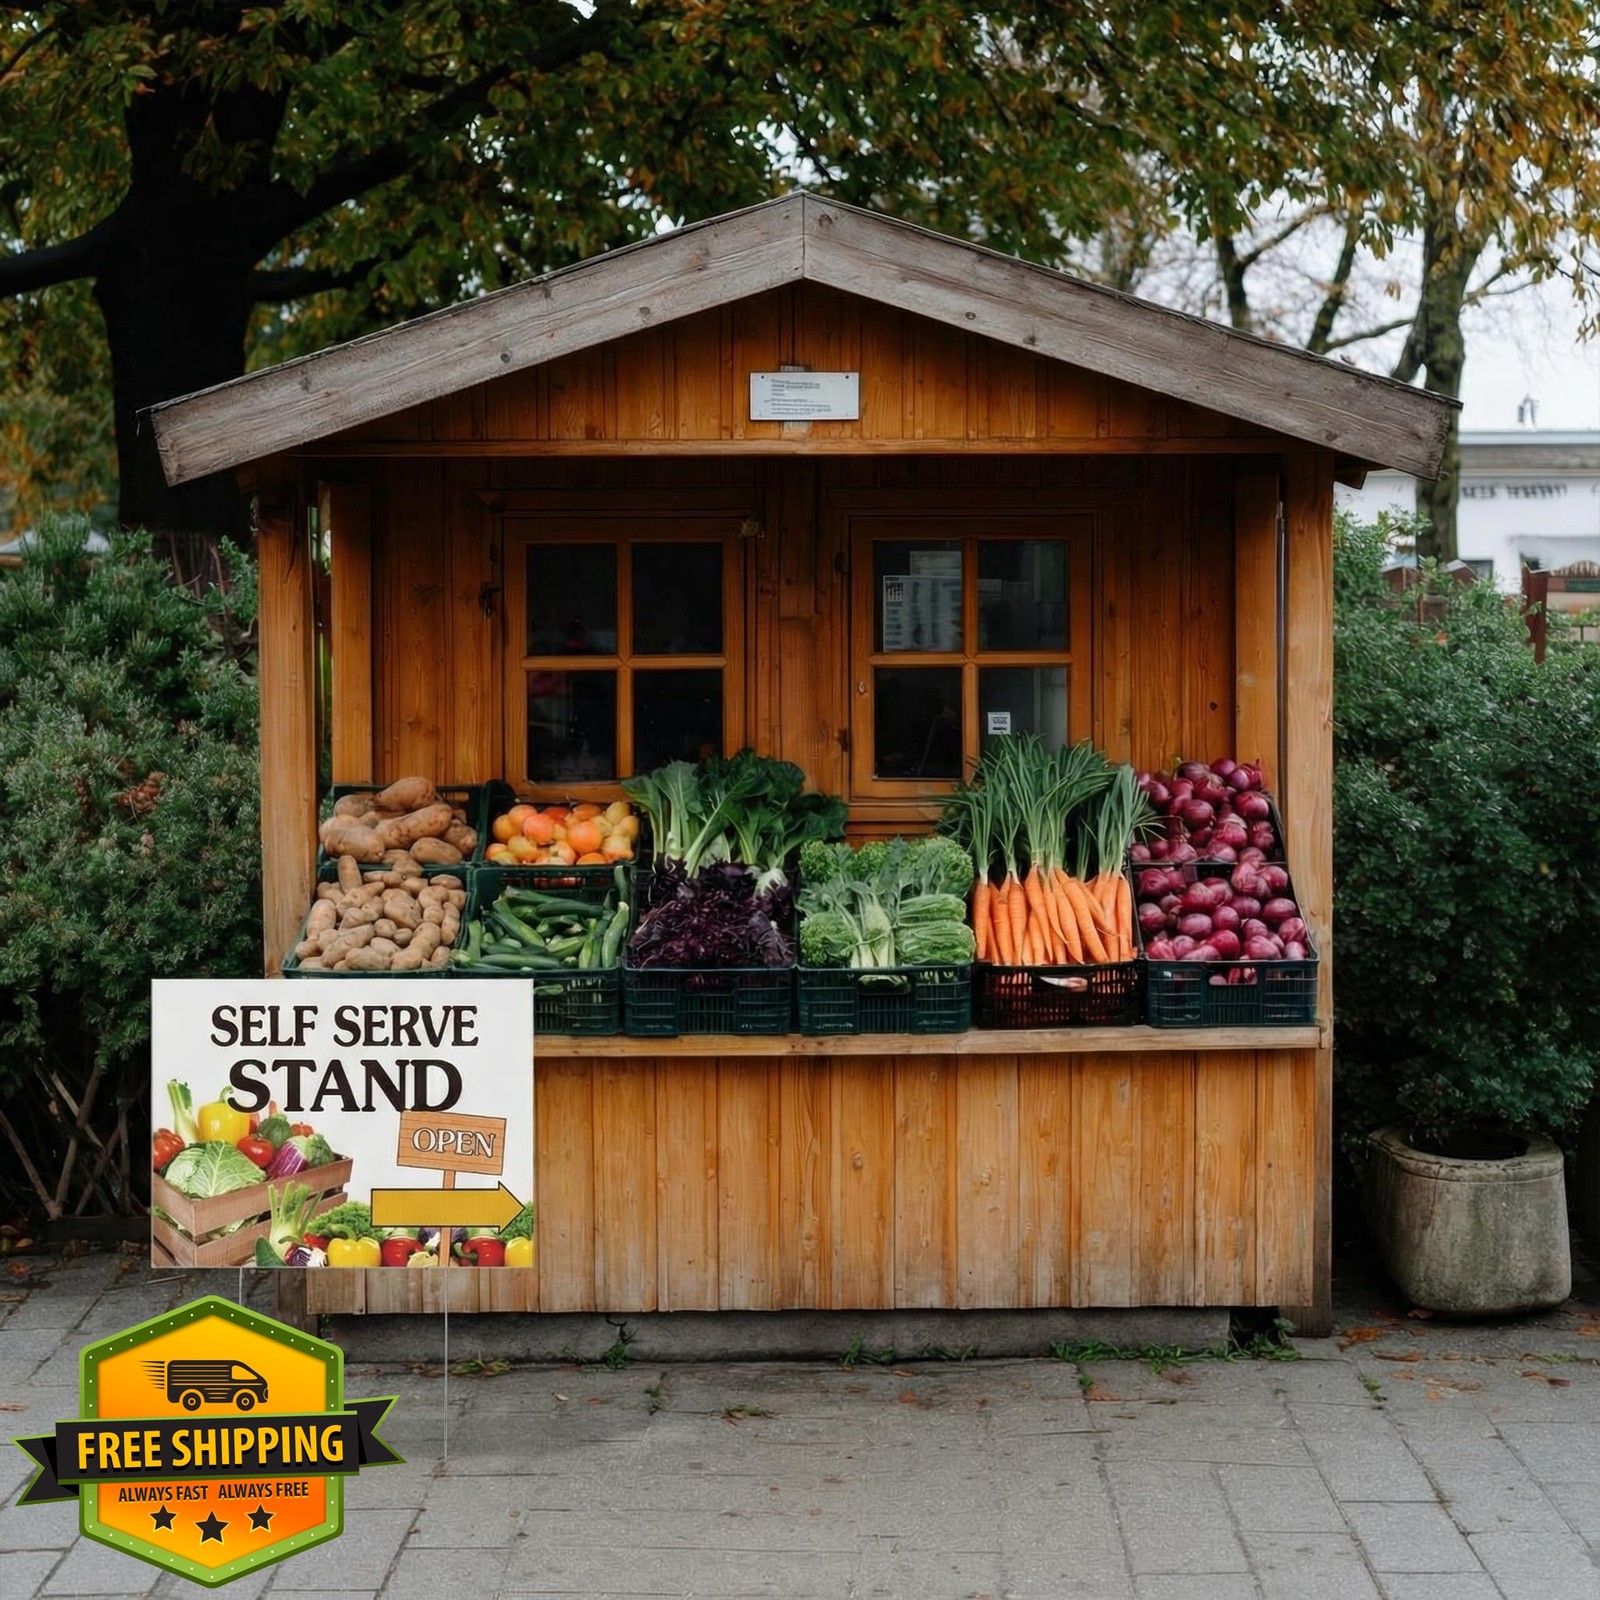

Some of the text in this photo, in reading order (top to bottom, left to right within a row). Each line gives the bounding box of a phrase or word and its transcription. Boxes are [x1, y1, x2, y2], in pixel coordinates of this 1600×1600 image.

[210, 1005, 479, 1047] SELF SERVE
[227, 1059, 463, 1112] STAND
[412, 1127, 495, 1158] OPEN
